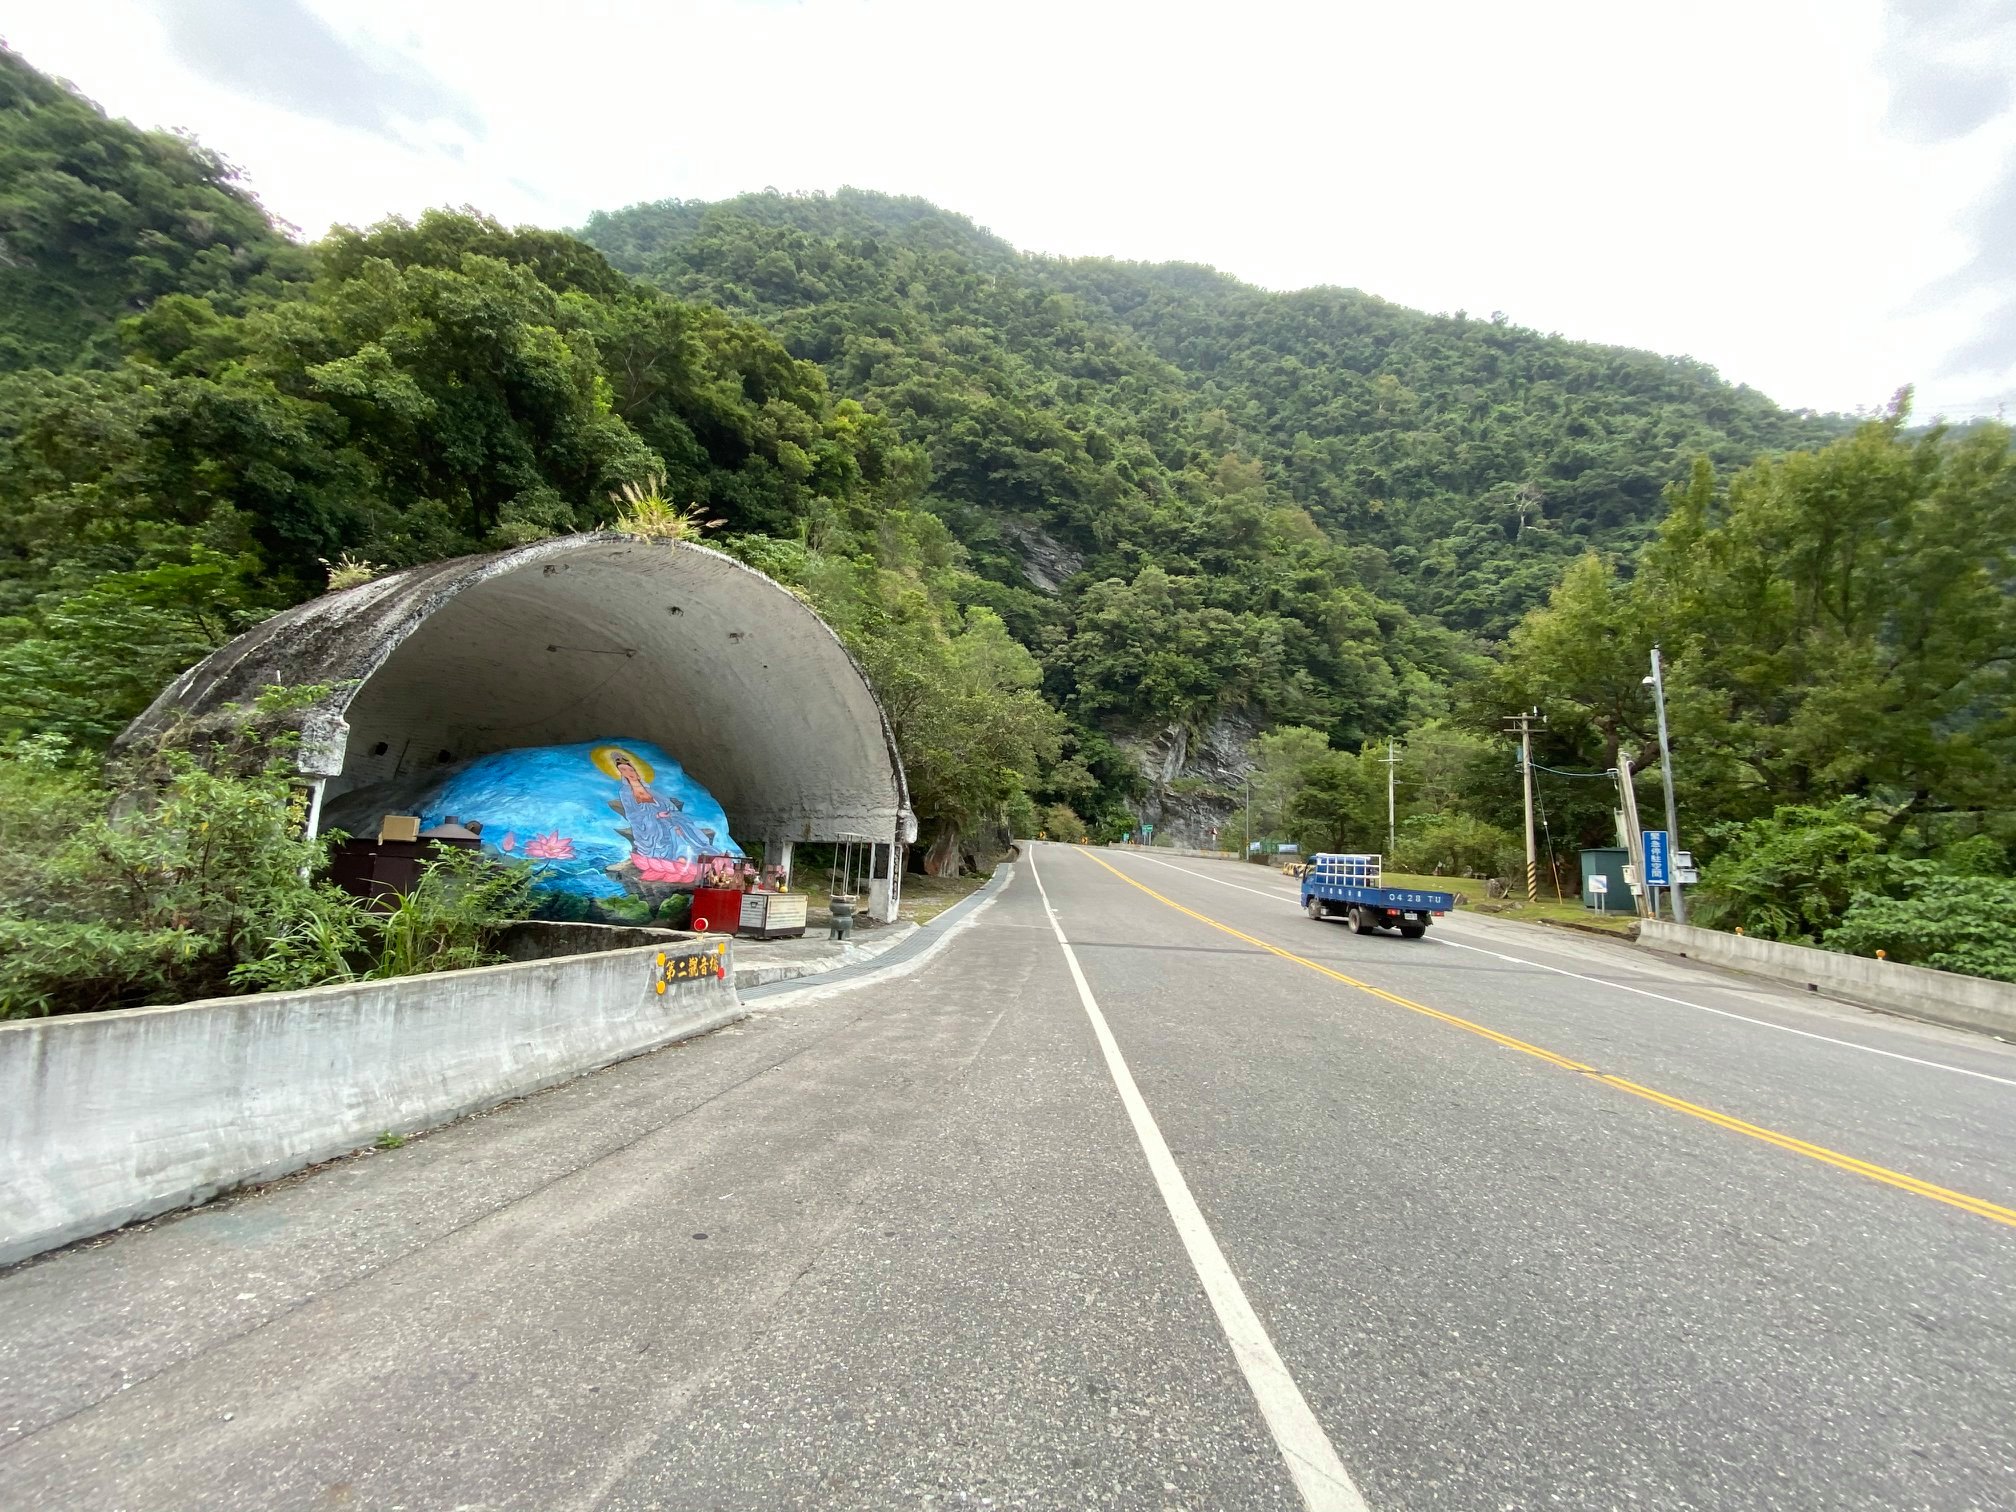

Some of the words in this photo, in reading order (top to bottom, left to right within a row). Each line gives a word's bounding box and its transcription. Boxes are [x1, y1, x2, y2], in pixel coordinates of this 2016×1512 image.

[666, 954, 719, 982] 第二觀音橋
